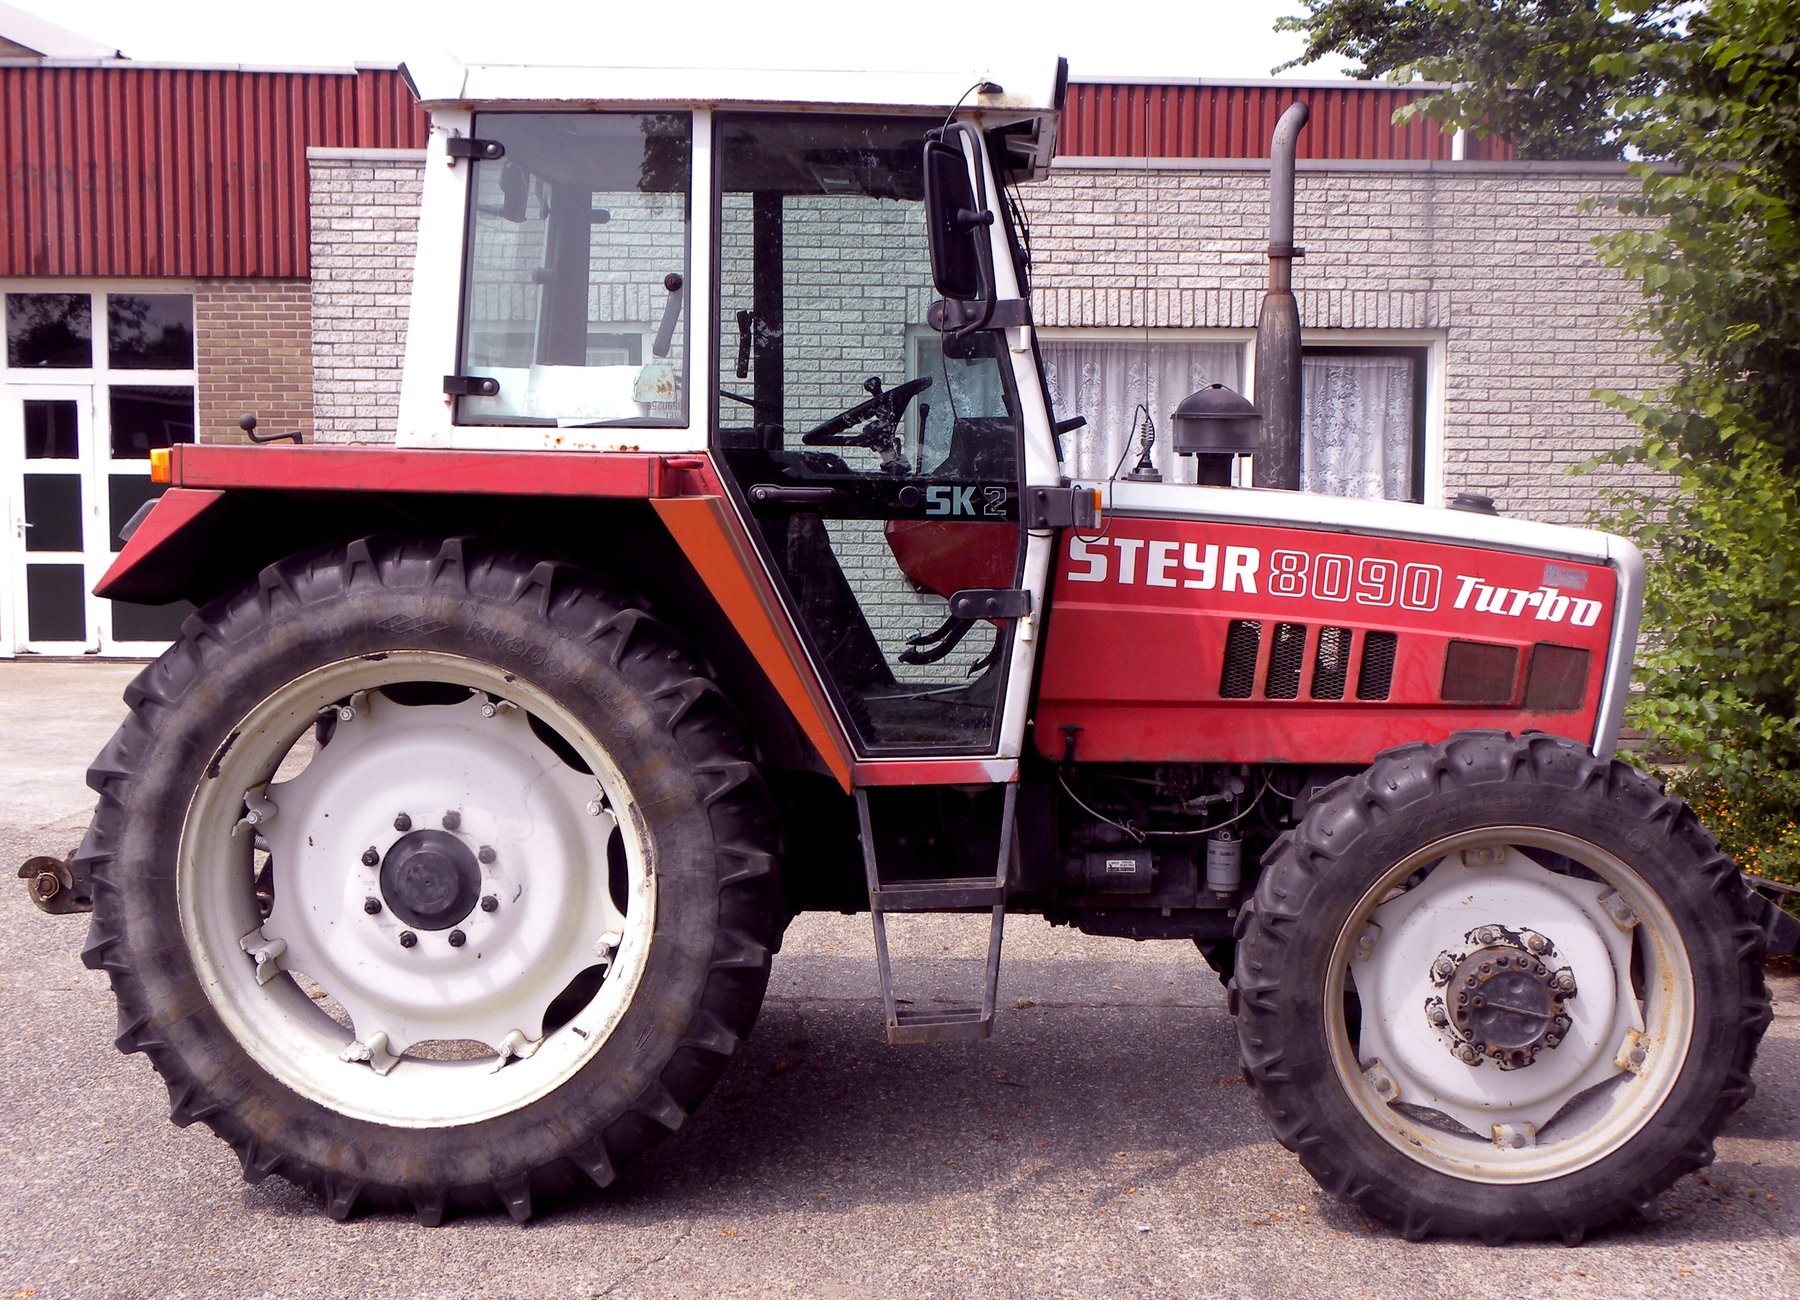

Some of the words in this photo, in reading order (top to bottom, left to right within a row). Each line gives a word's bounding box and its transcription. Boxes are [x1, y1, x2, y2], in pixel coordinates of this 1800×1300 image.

[926, 486, 976, 515] SK
[983, 486, 1007, 515] 2
[1067, 536, 1260, 594] STEYR
[1267, 549, 1443, 612] 8090
[1454, 574, 1603, 628] Turbo
